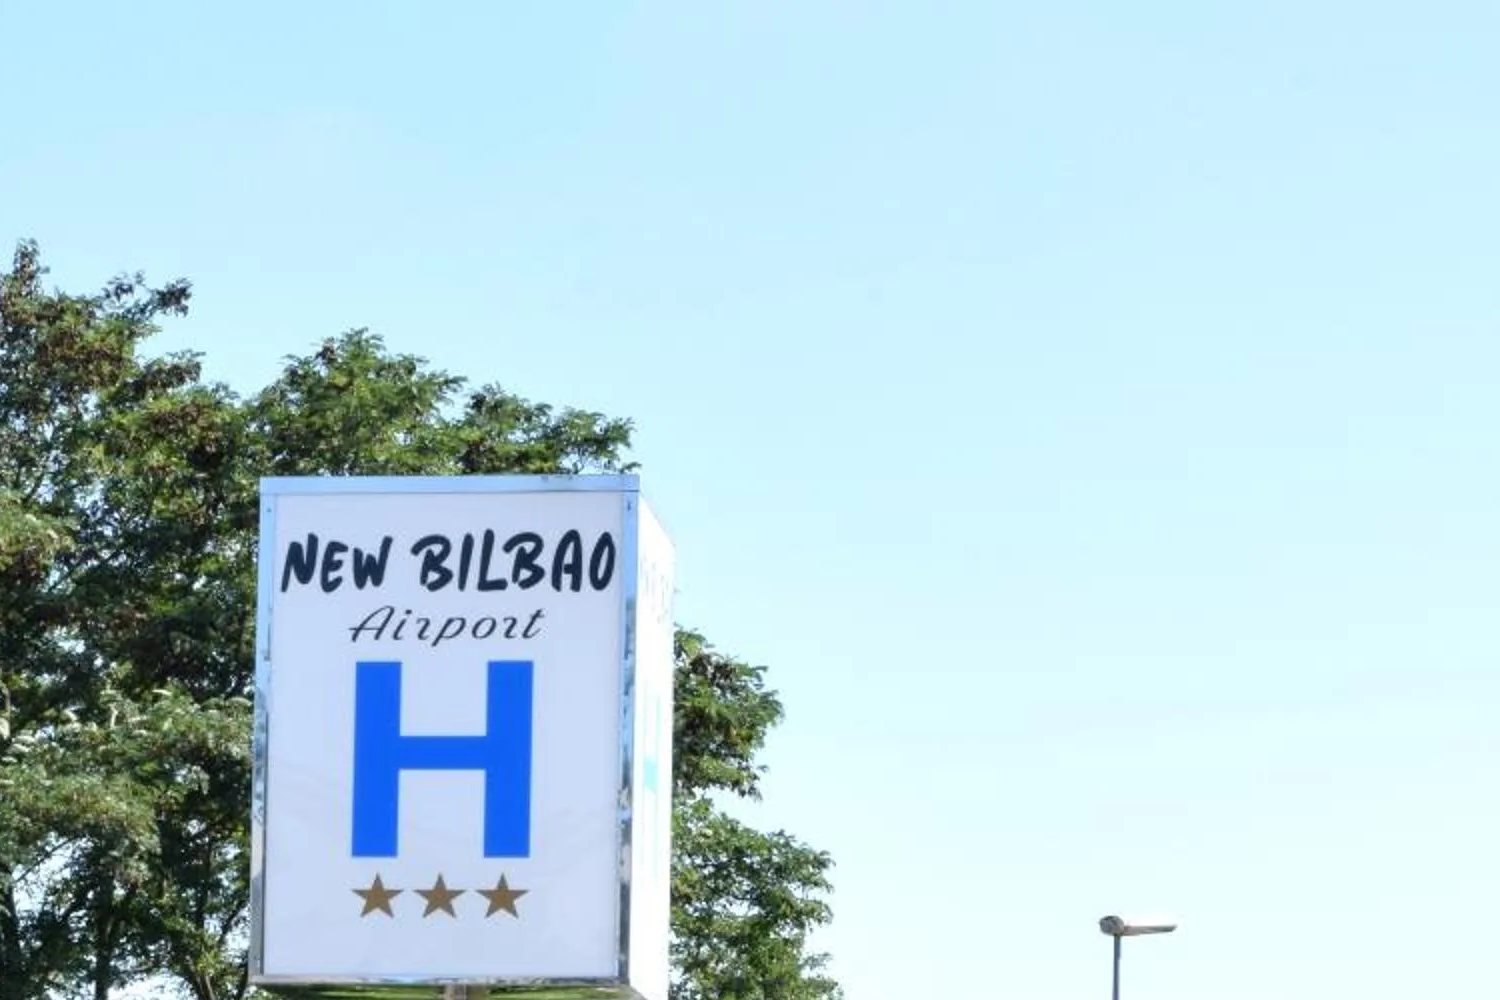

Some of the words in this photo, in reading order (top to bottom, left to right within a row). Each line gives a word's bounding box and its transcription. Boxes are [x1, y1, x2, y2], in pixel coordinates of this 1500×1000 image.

[280, 532, 393, 594] NEW
[410, 529, 617, 593] BILBAO
[349, 605, 546, 647] Airport
[351, 659, 534, 858] H
